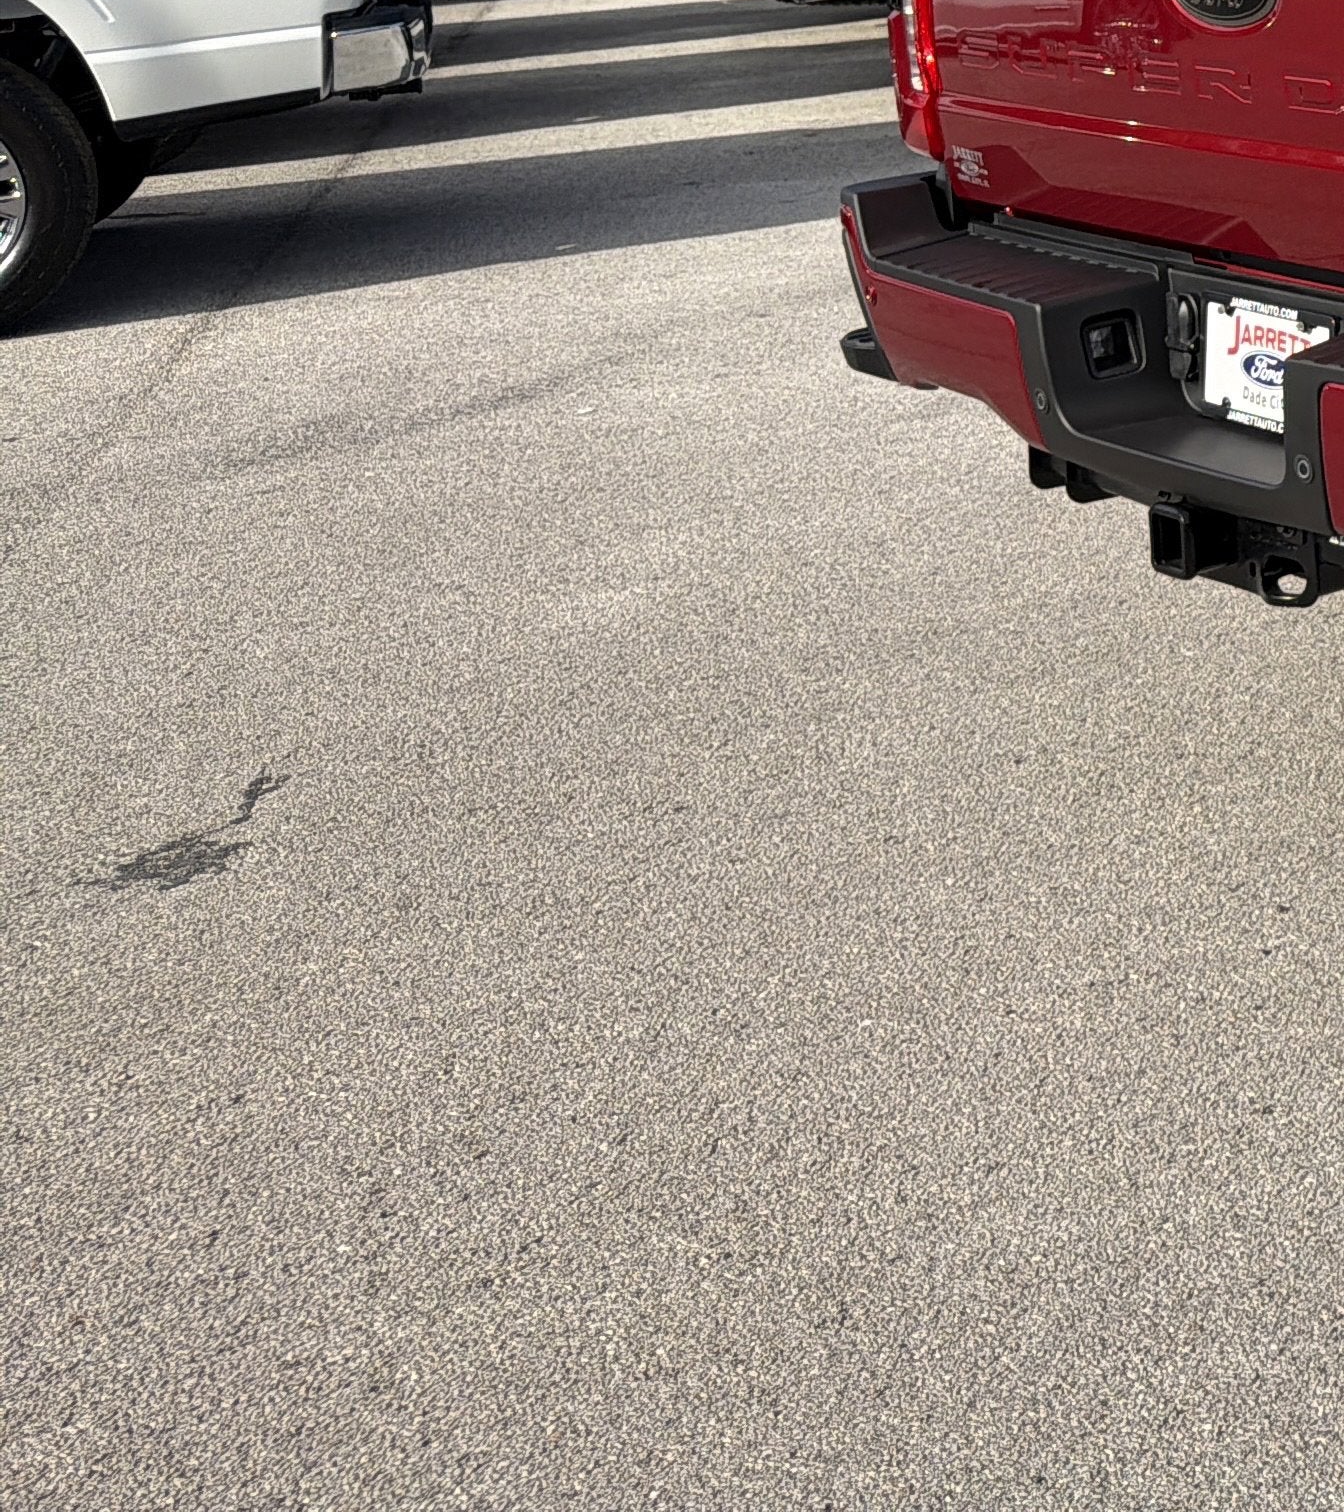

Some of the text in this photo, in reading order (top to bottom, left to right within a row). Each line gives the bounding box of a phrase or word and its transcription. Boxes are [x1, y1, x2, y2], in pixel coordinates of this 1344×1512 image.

[956, 30, 1253, 104] SUPER
[1230, 297, 1298, 319] JARRETTAUTO.COM
[1243, 386, 1267, 407] Dade
[1226, 410, 1285, 434] JARRETTAUTO.C
